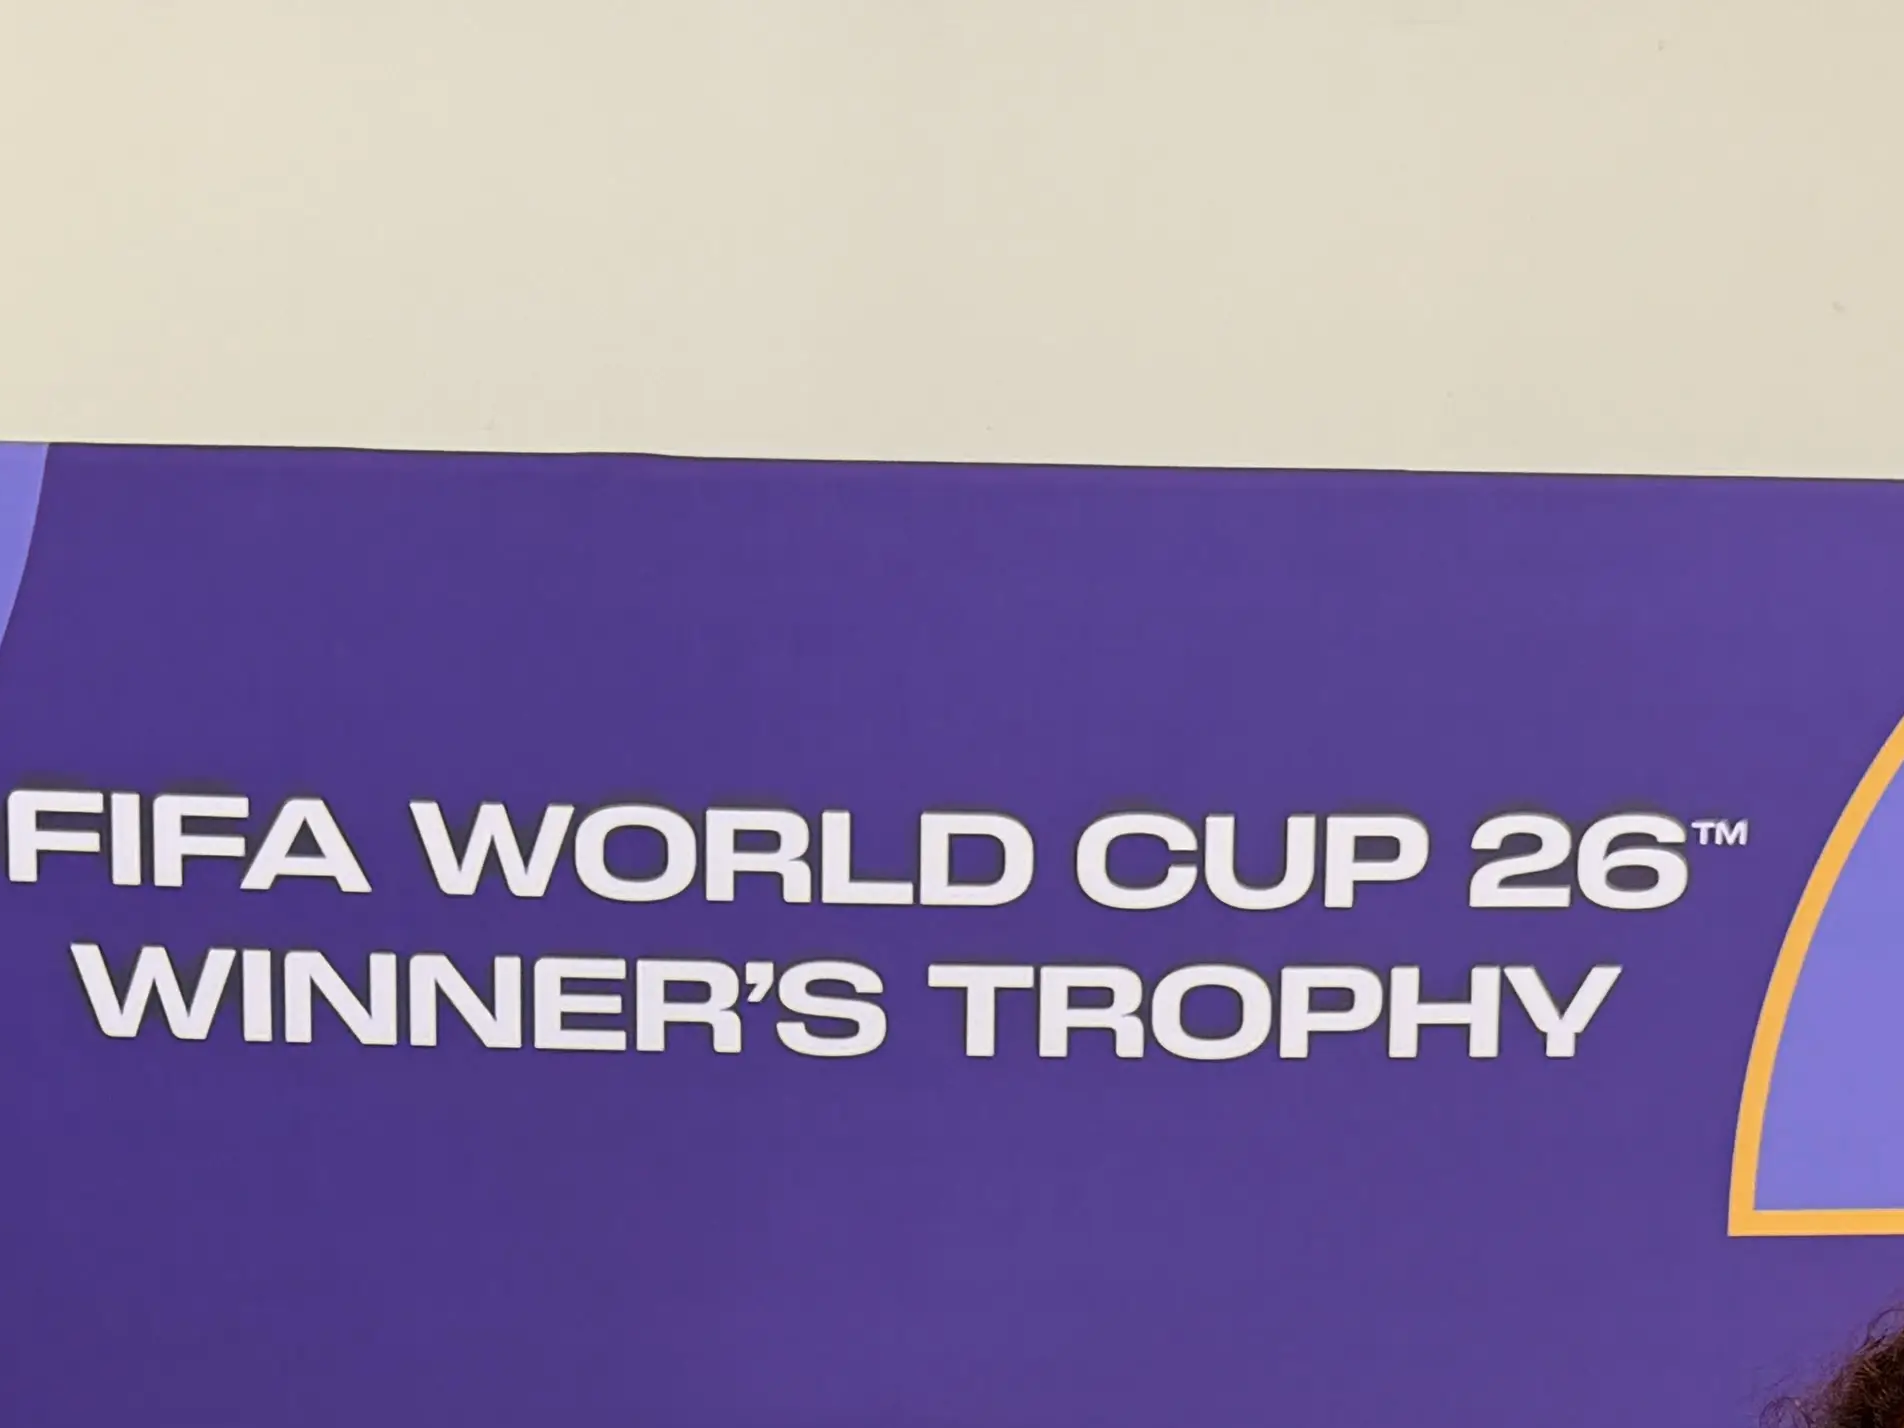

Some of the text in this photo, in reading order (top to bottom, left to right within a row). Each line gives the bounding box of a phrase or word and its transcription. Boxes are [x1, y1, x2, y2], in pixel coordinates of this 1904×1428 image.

[5, 790, 369, 894] FIFA
[412, 801, 1032, 908] WORLD
[1076, 812, 1430, 911] CUP
[71, 942, 1621, 1060] WINNER'S TROPHY
